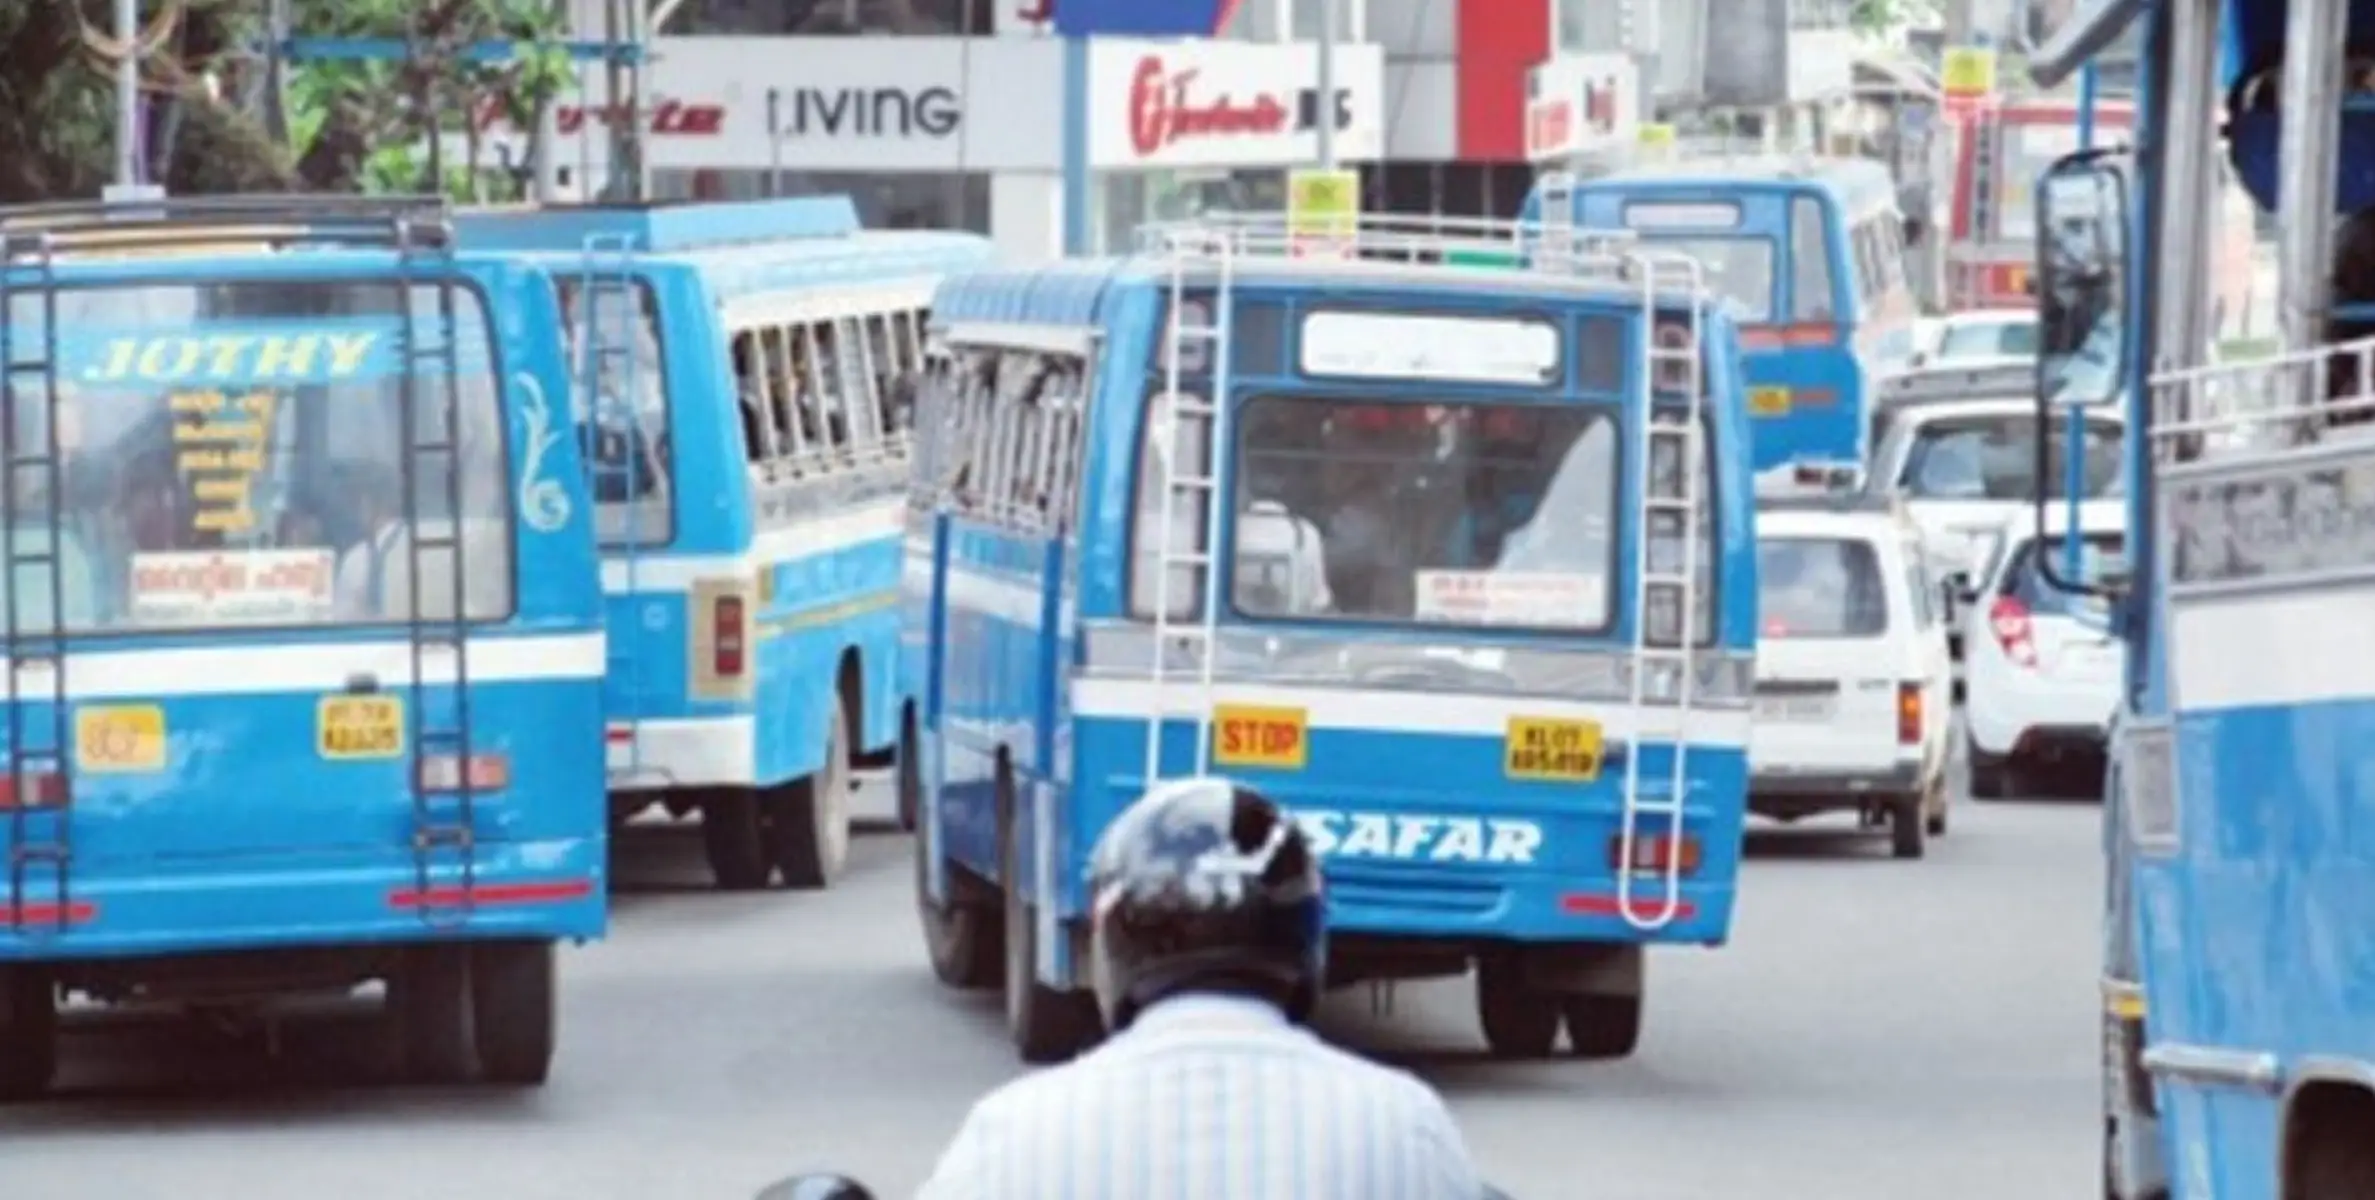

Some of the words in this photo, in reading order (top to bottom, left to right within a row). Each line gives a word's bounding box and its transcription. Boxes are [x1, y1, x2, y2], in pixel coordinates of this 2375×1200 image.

[83, 332, 378, 381] JOTHY
[1222, 718, 1300, 756] STOP
[1293, 809, 1542, 863] SAFAR
